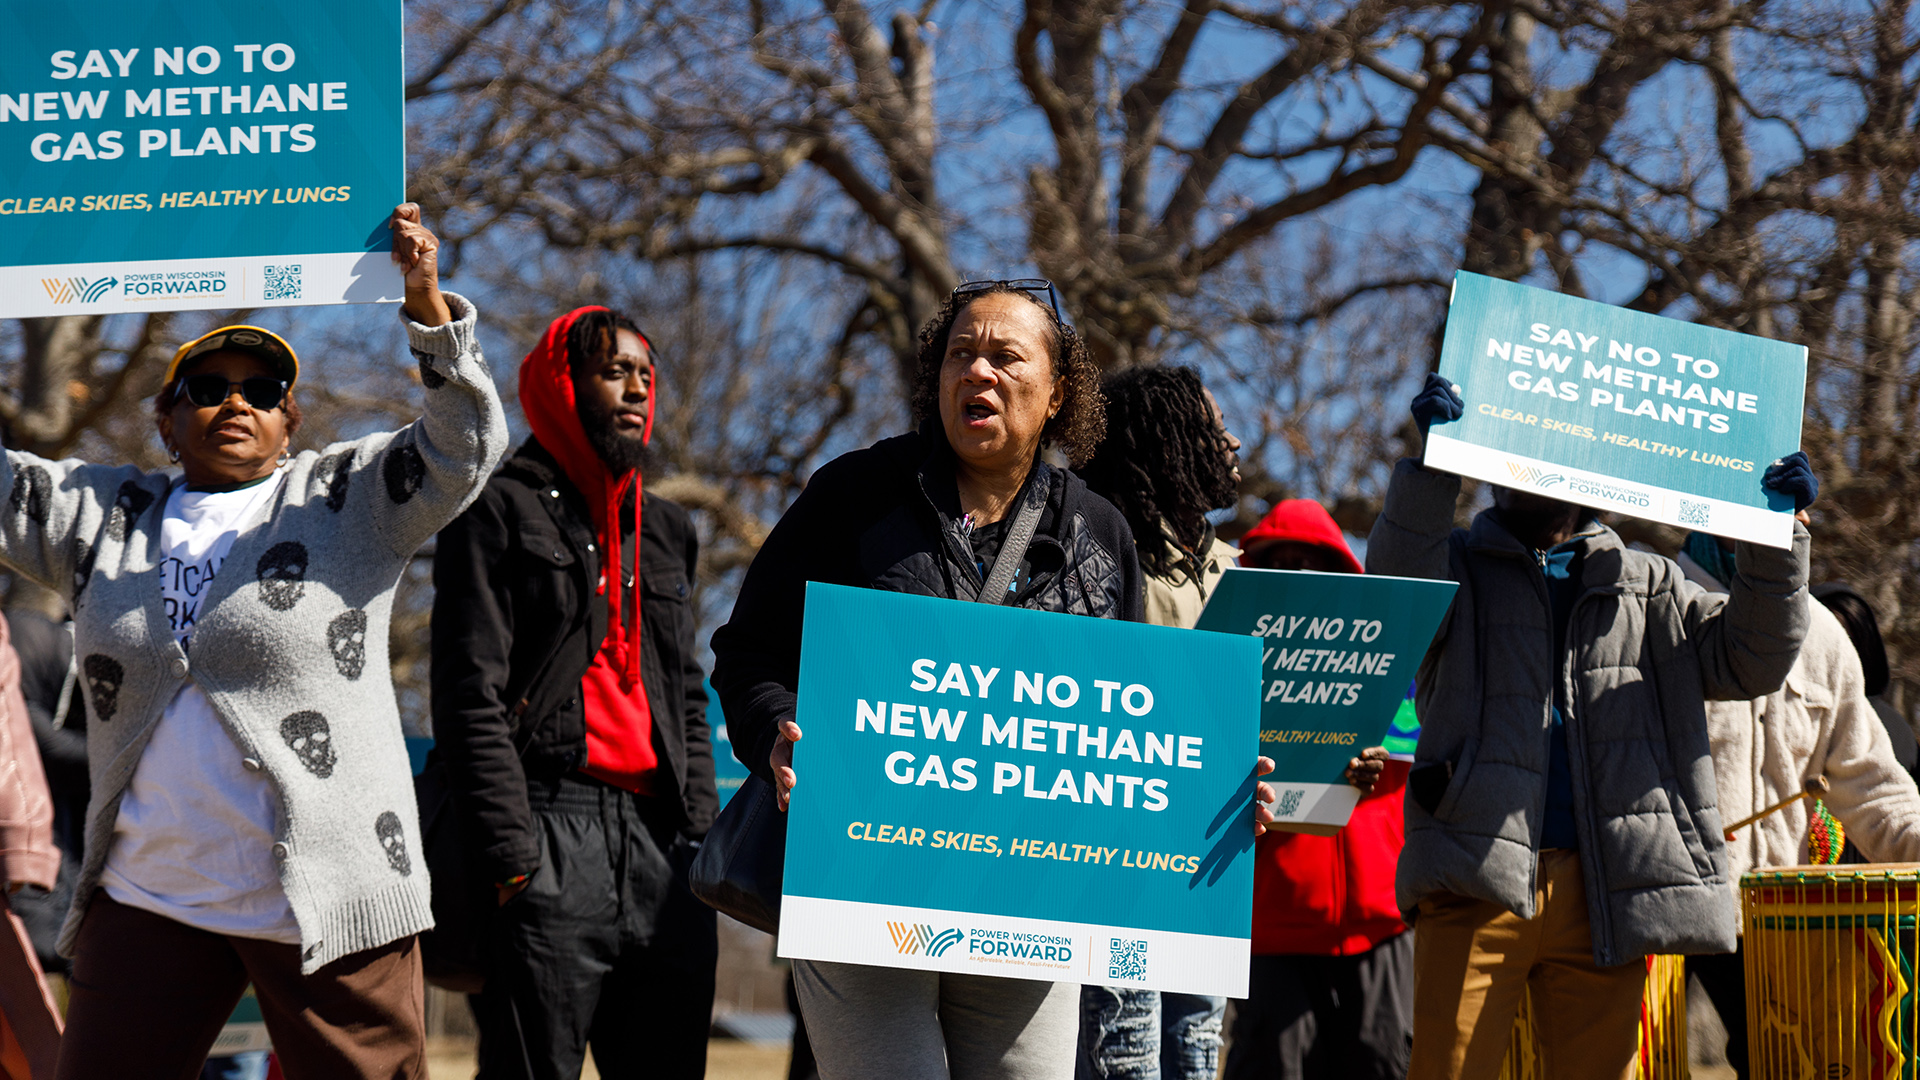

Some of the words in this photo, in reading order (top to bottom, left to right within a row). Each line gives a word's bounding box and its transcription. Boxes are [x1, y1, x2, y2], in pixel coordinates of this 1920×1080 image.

[50, 48, 139, 80] SAY
[154, 45, 221, 76] NO
[233, 43, 296, 73] TO
[0, 90, 110, 122] NEW
[125, 82, 348, 118] METHANE
[30, 130, 124, 162] GAS
[139, 124, 317, 158] PLANTS
[0, 196, 76, 215] CLEAR
[80, 193, 153, 212] SKIES,
[159, 189, 268, 208] HEALTHY
[272, 186, 351, 204] LUNGS
[124, 273, 163, 282] POWER
[166, 271, 225, 280] WISCONSIN
[124, 279, 226, 295] FORWARD
[1529, 322, 1600, 354] SAY
[1608, 339, 1660, 367] NO
[1671, 353, 1720, 379] TO
[1486, 338, 1573, 374] NEW
[1583, 359, 1758, 414] METHANE
[1508, 370, 1580, 402] GAS
[1590, 387, 1731, 434] PLANTS
[1478, 403, 1538, 426] CLEAR
[1541, 418, 1597, 442] SKIES,
[1602, 431, 1687, 458] HEALTHY
[1691, 450, 1754, 473] LUNGS
[1569, 482, 1650, 507] FORWARD
[1570, 477, 1601, 487] POWER
[1603, 483, 1650, 498] WISCONSIN
[1251, 614, 1306, 639] SAY
[1304, 617, 1344, 641] NO
[1349, 619, 1383, 643] TO
[1273, 648, 1395, 676] METHANE
[910, 658, 1001, 699] SAY
[1012, 670, 1081, 708] NO
[1093, 680, 1154, 717] TO
[1265, 680, 1363, 706] PLANTS
[854, 699, 968, 742] NEW
[981, 713, 1203, 770] METHANE
[1259, 730, 1316, 743] HEALTHY
[1313, 731, 1358, 745] LUNGS
[884, 751, 978, 791] GAS
[993, 761, 1169, 812] PLANTS
[846, 822, 926, 847] CLEAR
[930, 830, 1003, 858] SKIES,
[1009, 838, 1119, 866] HEALTHY
[1121, 850, 1201, 874] LUNGS
[969, 938, 1072, 962] FORWARD
[970, 928, 1009, 940] POWER
[1013, 932, 1072, 946] WISCONSIN
